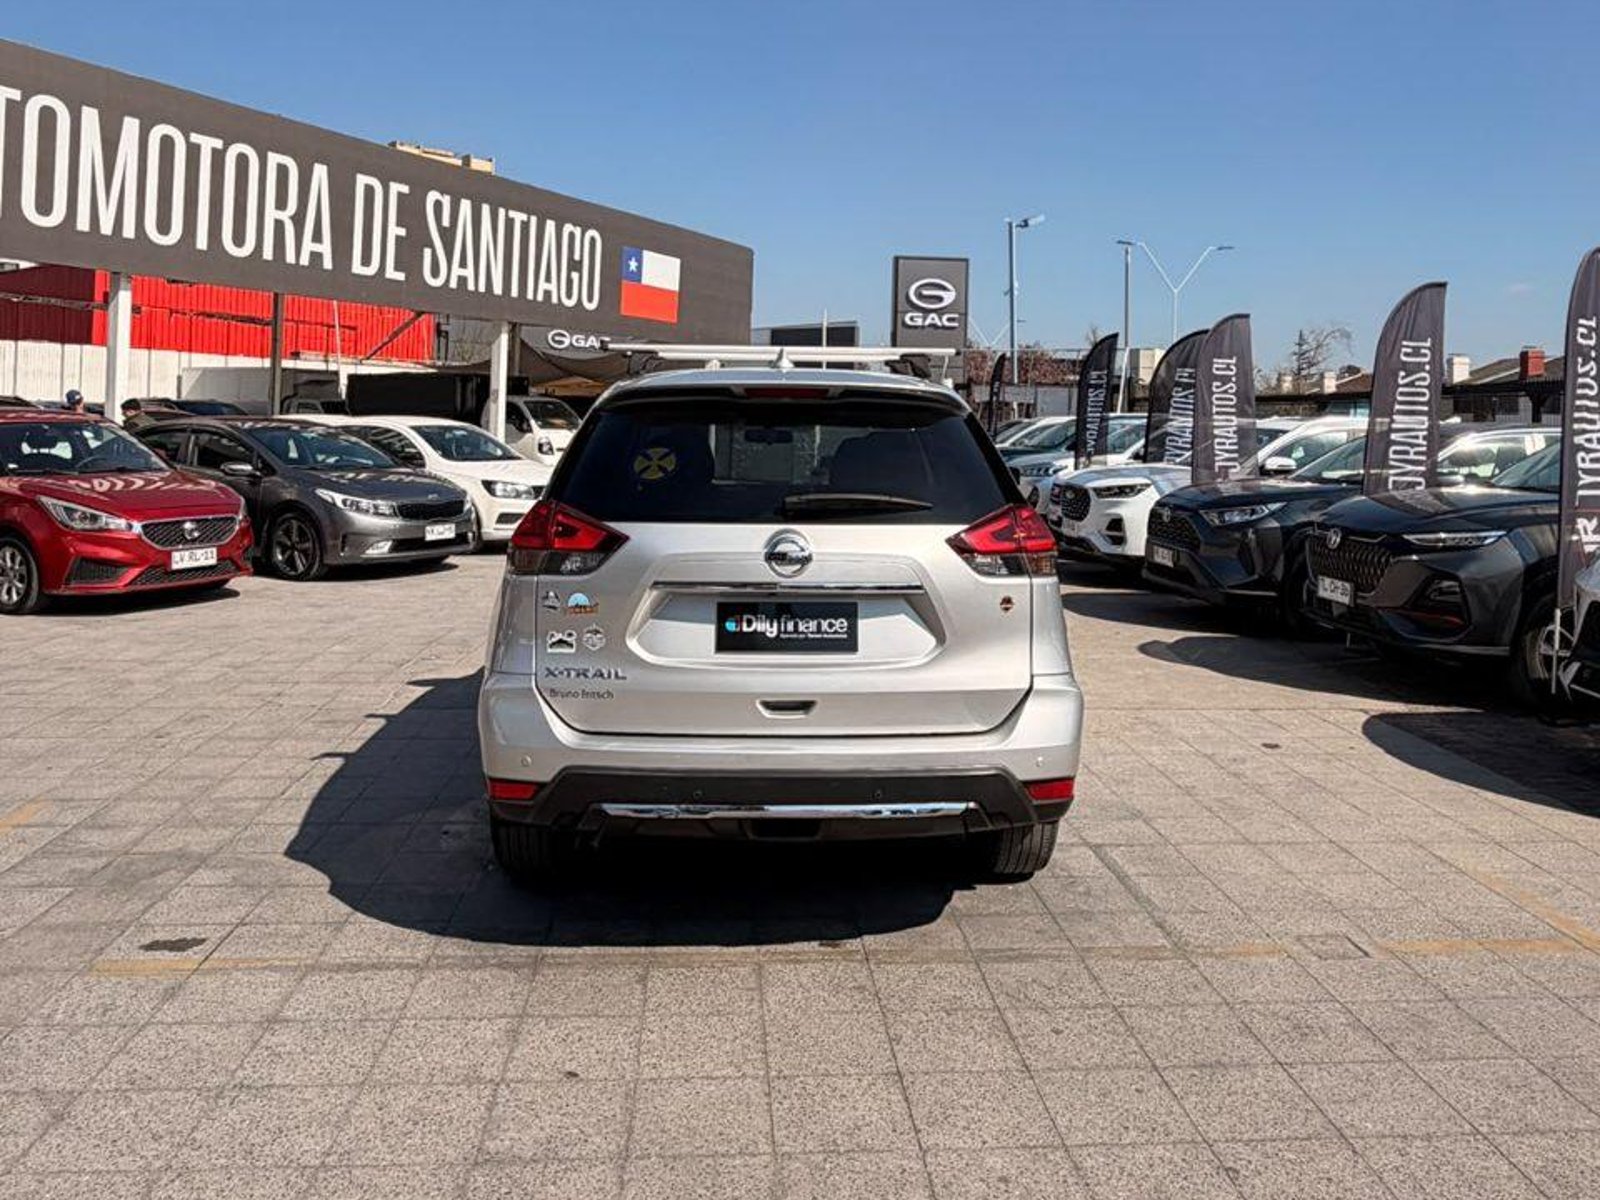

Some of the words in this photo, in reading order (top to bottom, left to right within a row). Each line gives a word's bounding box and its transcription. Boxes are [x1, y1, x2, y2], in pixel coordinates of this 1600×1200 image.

[351, 172, 410, 281] DE
[422, 189, 602, 311] SANTIAGO
[904, 312, 960, 327] GAC
[1211, 355, 1241, 473] JYRAUTOS.CL
[1388, 337, 1432, 490] JYRAUTOS.CL
[780, 614, 848, 633] finance
[545, 667, 627, 680] X-TRAIL
